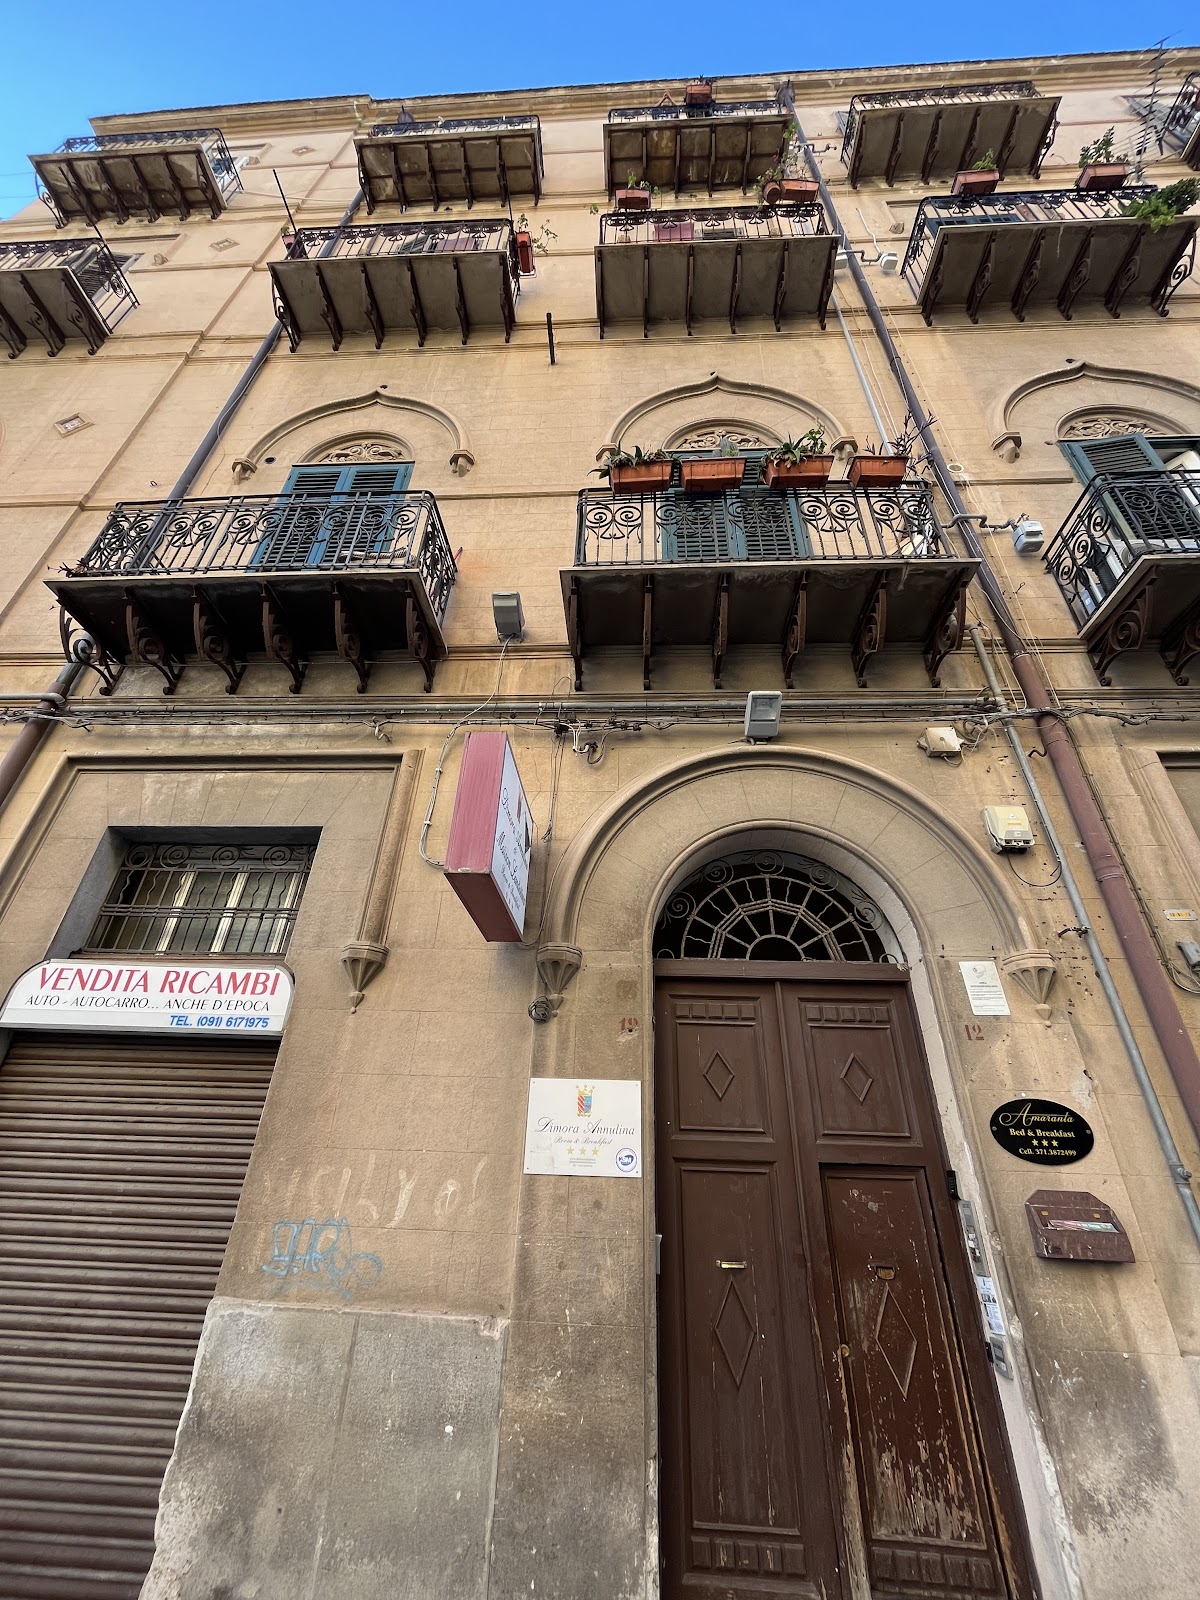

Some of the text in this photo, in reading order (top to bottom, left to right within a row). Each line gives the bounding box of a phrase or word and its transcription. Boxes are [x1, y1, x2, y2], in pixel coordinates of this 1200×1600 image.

[38, 967, 281, 996] VENDITA RICAMBI
[25, 995, 60, 1006] AUTO
[164, 999, 208, 1011] ANCHE
[212, 999, 270, 1012] D'EPOCA
[169, 1015, 270, 1028] TEL. (091) 6171975
[964, 1024, 985, 1041] 12
[999, 1102, 1075, 1126] Amaranta
[535, 1116, 580, 1134] Dimora
[1009, 1128, 1076, 1138] Bed & Breakfast
[581, 1137, 613, 1146] Breakfast
[1018, 1147, 1034, 1155] Cell.
